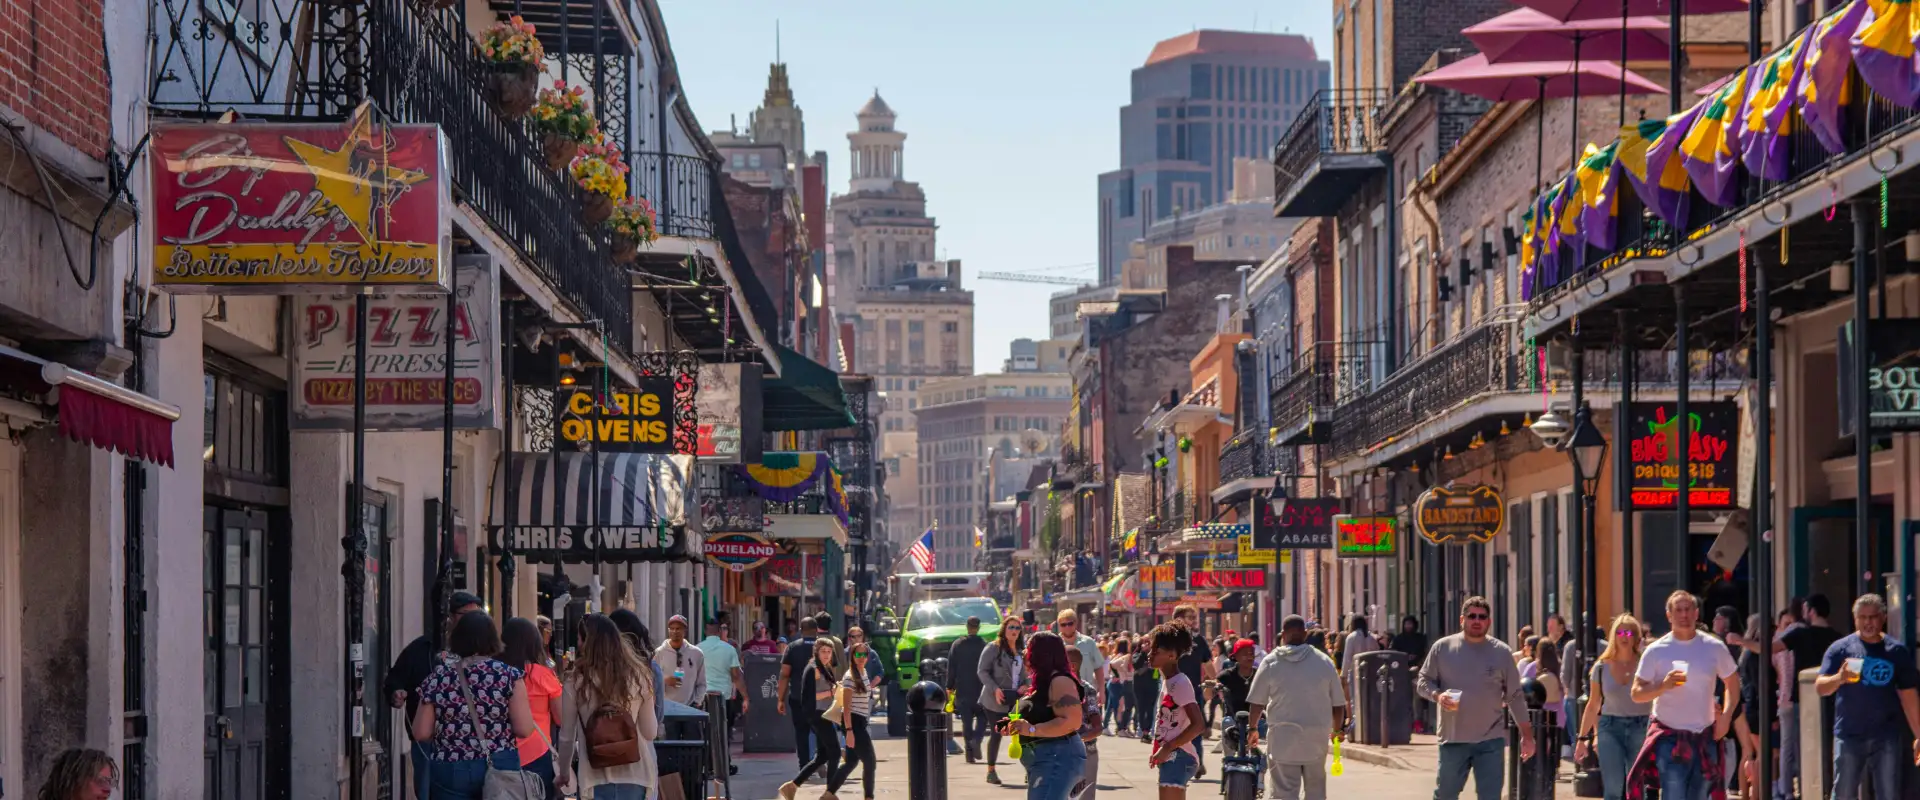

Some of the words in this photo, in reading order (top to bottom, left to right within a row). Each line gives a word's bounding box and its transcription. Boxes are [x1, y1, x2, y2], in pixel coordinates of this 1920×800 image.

[162, 190, 350, 253] Daddy's
[164, 245, 320, 277] Bottomless
[326, 246, 434, 281] Topless
[393, 381, 424, 400] THE
[427, 381, 477, 401] SLCE
[570, 392, 660, 416] CRIS
[562, 419, 667, 443] OWENS
[1632, 431, 1668, 462] BIG
[583, 527, 674, 549] OWENS
[704, 541, 775, 556] DIXIELAND
[1270, 534, 1334, 544] CABARE
[1212, 560, 1242, 568] HUSTLE
